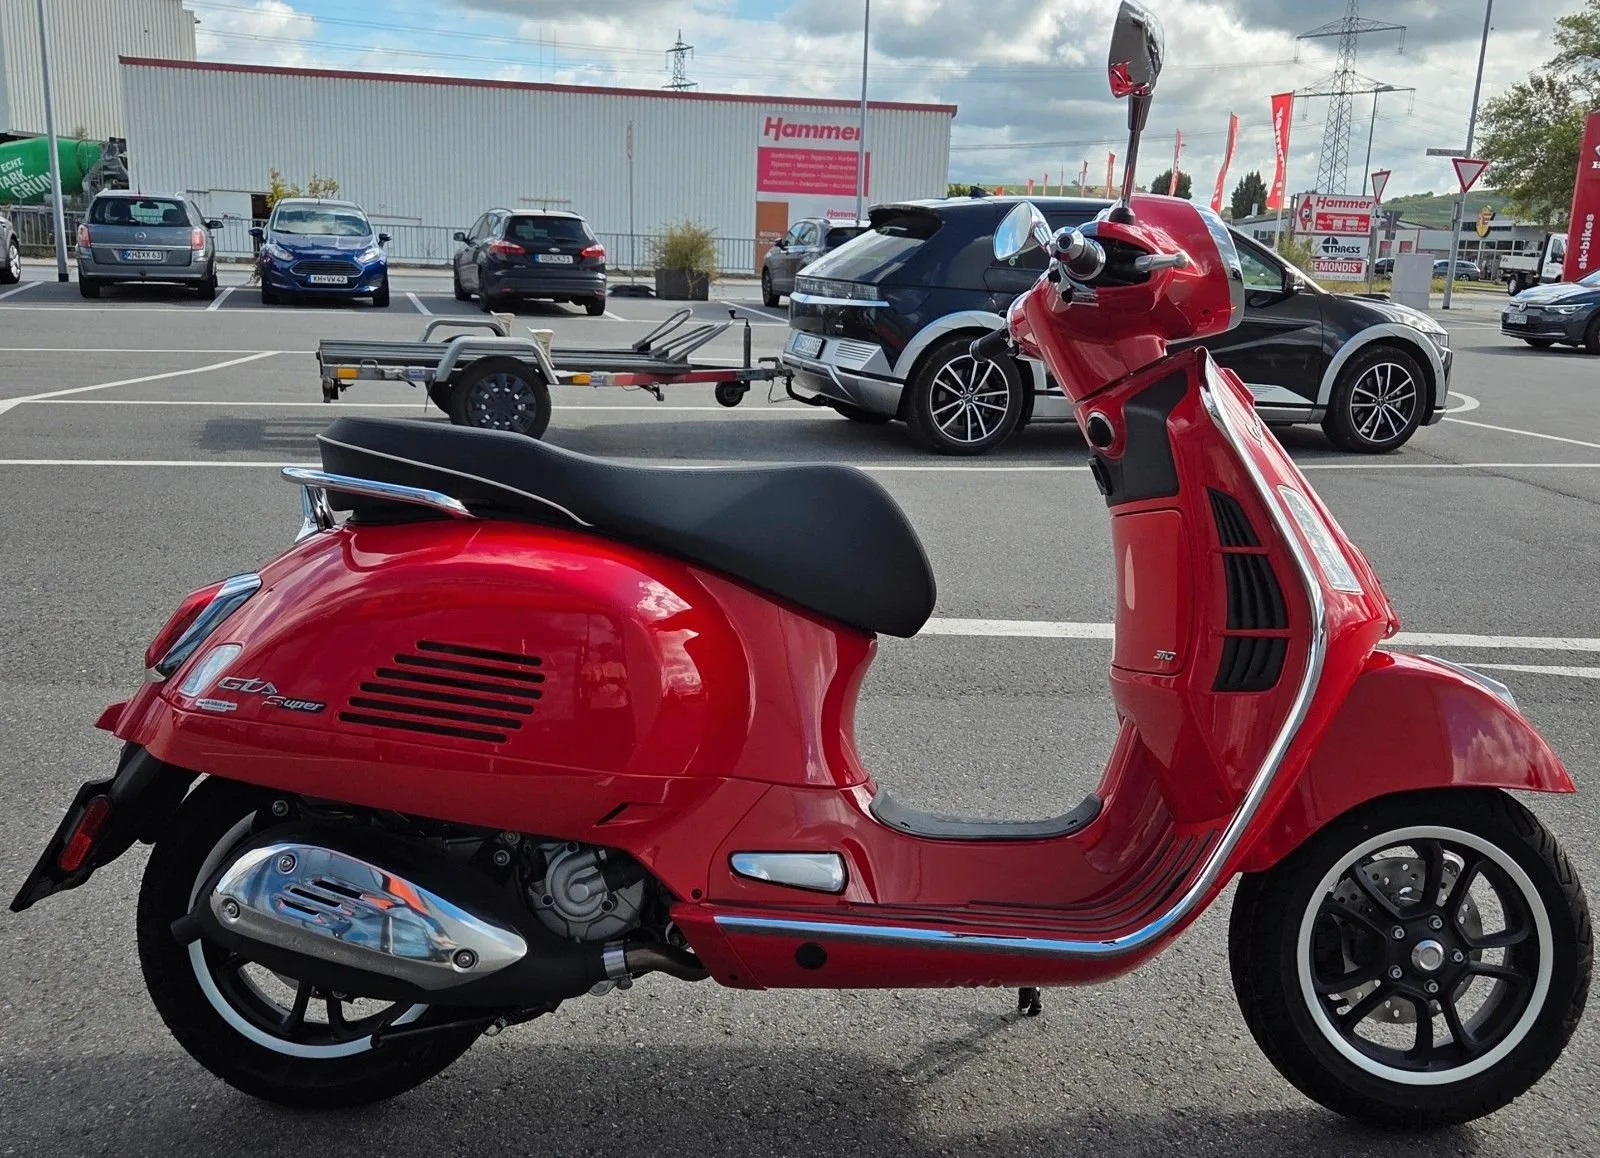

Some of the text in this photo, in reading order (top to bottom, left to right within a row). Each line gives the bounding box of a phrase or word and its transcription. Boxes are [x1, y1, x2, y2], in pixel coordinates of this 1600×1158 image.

[764, 116, 861, 141] Hammer
[1316, 196, 1372, 209] Hammer
[826, 208, 857, 219] Hamme
[262, 695, 325, 712] Super
